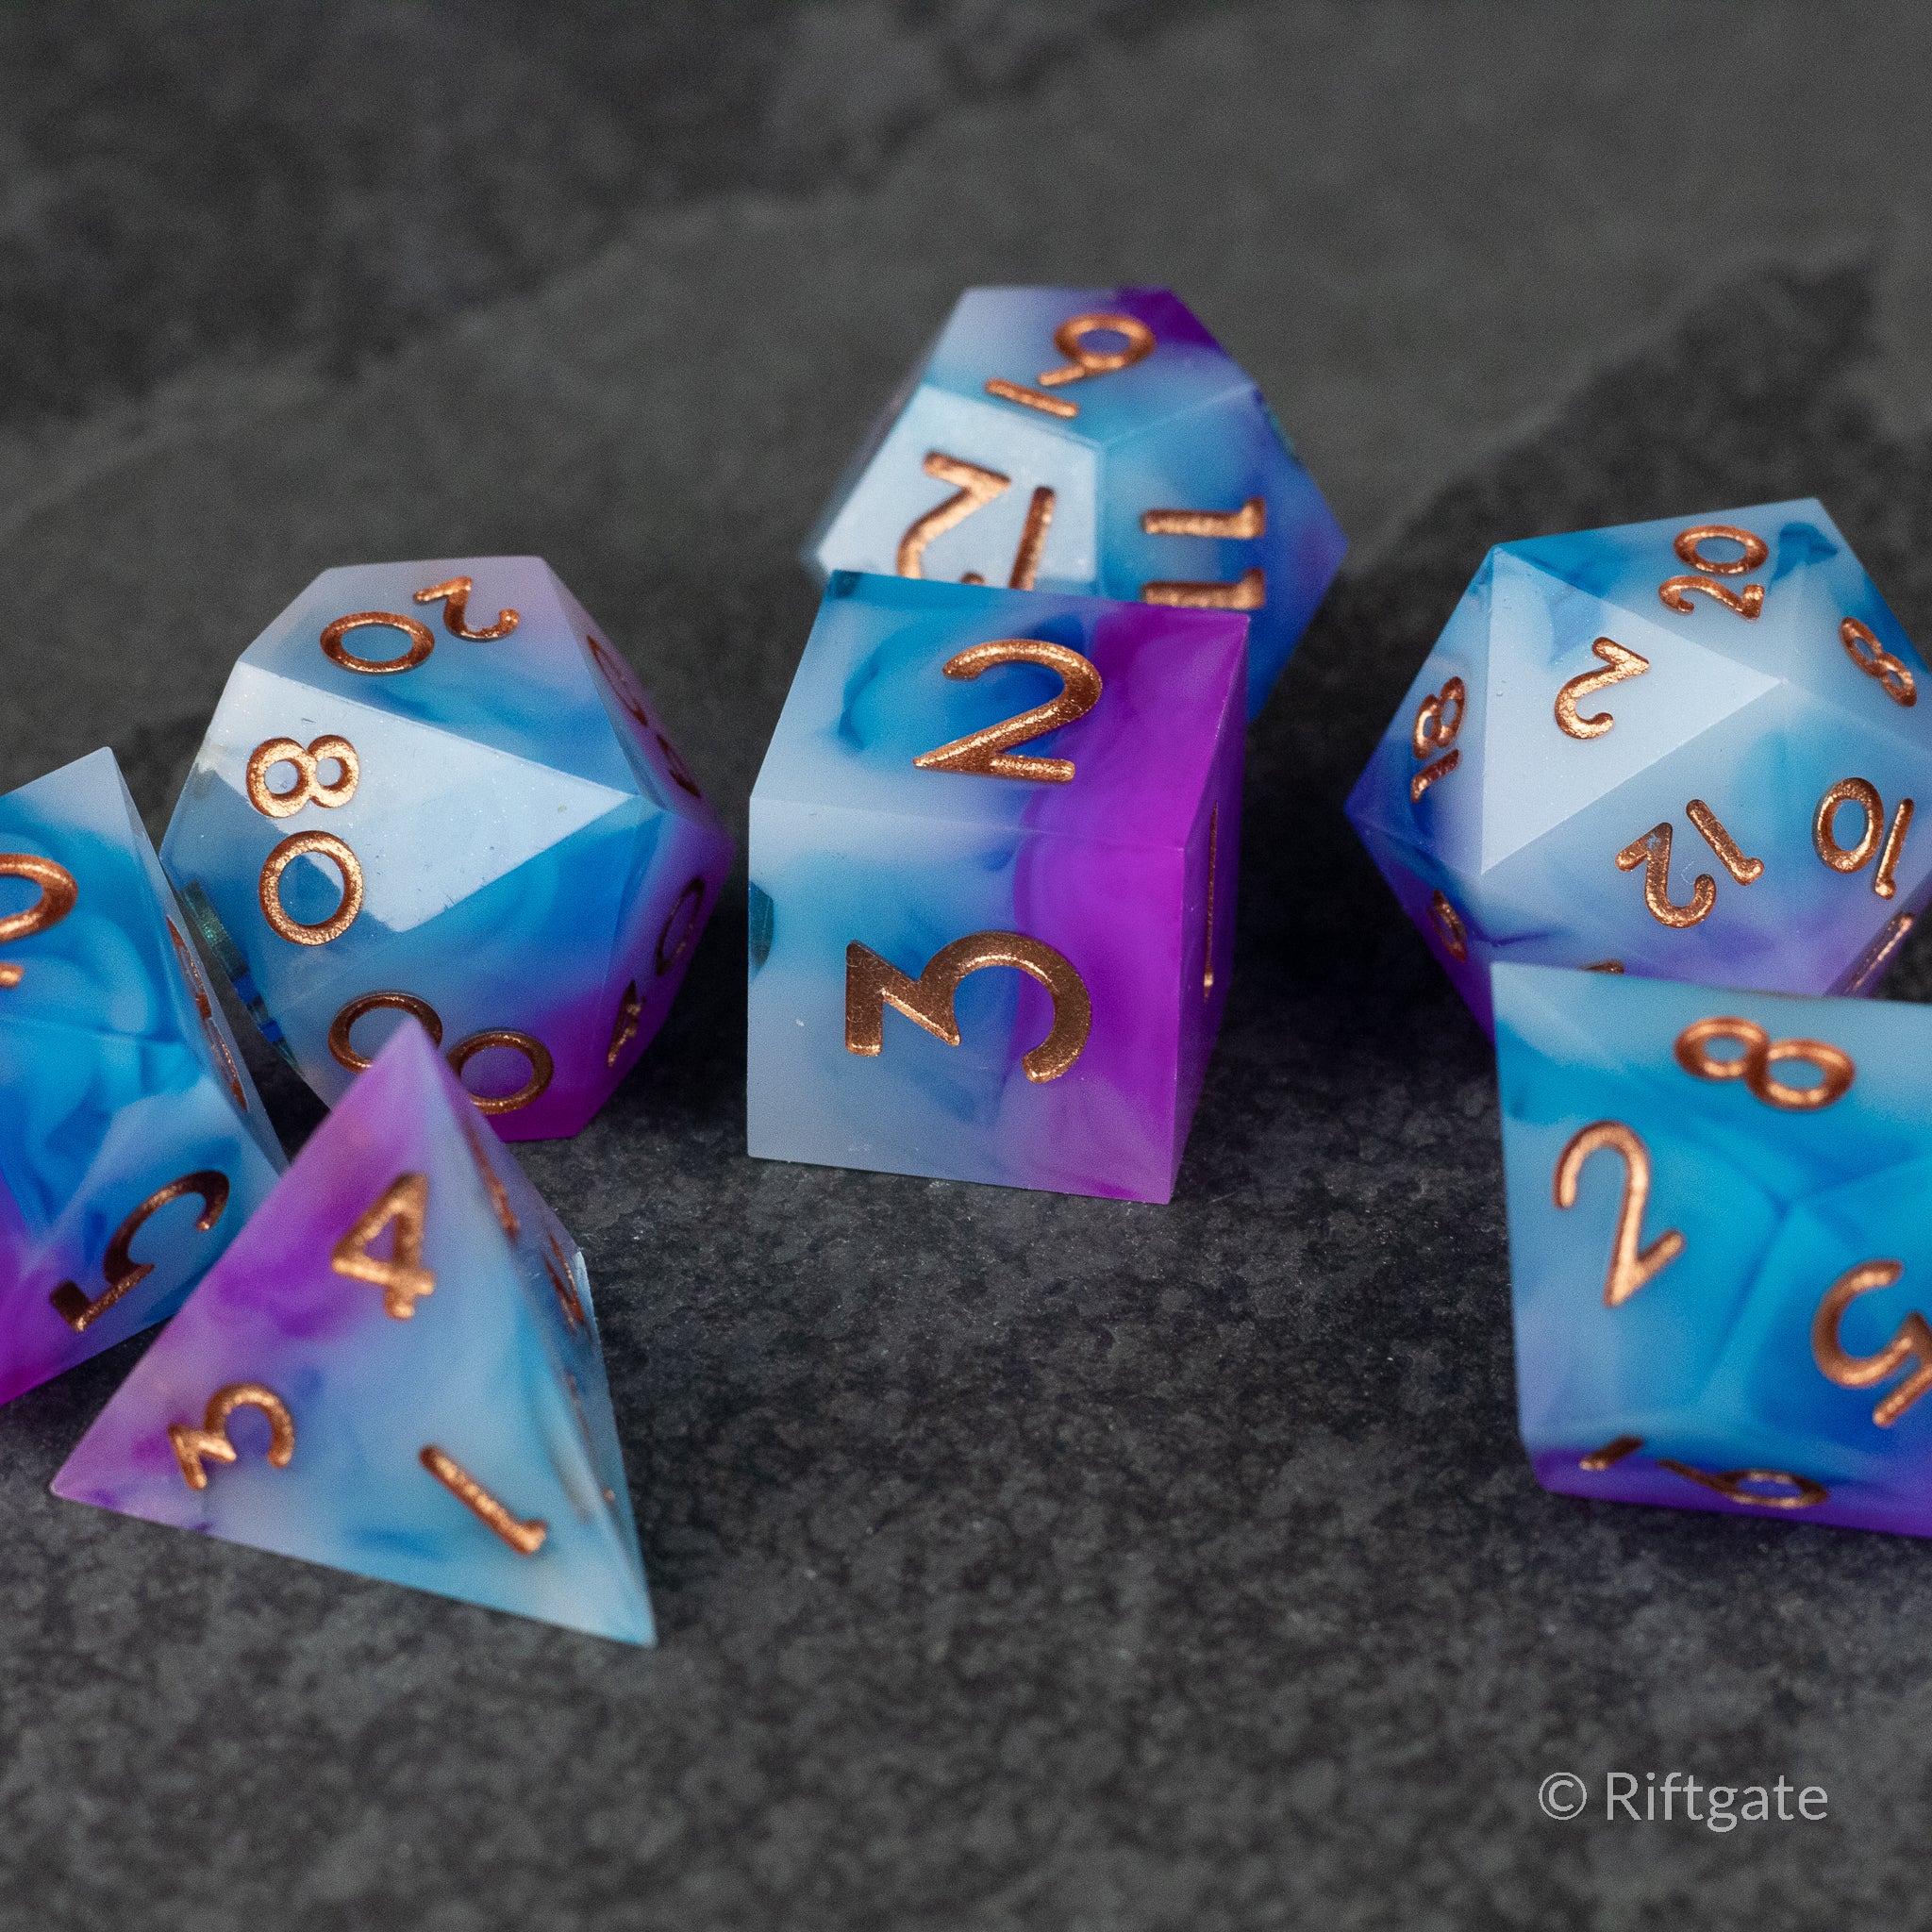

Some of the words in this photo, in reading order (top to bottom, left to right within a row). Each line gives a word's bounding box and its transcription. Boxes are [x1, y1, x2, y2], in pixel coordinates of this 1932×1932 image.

[1141, 495, 1266, 610] 11
[1658, 525, 1769, 621] 20
[320, 575, 520, 675] 20
[1840, 617, 1918, 707] 8
[913, 639, 1102, 783] 2
[1411, 676, 1465, 802] 18
[1555, 637, 1649, 739] 2
[246, 734, 363, 946] 80
[1615, 799, 1764, 929] 12
[1816, 777, 1914, 899] 10
[845, 930, 1091, 1083] 3
[1674, 1015, 1855, 1111] 8
[50, 1171, 229, 1332] 5
[331, 1172, 435, 1321] 4
[1553, 1119, 1686, 1307] 2
[167, 1382, 295, 1490] 3
[418, 1444, 548, 1556] 1
